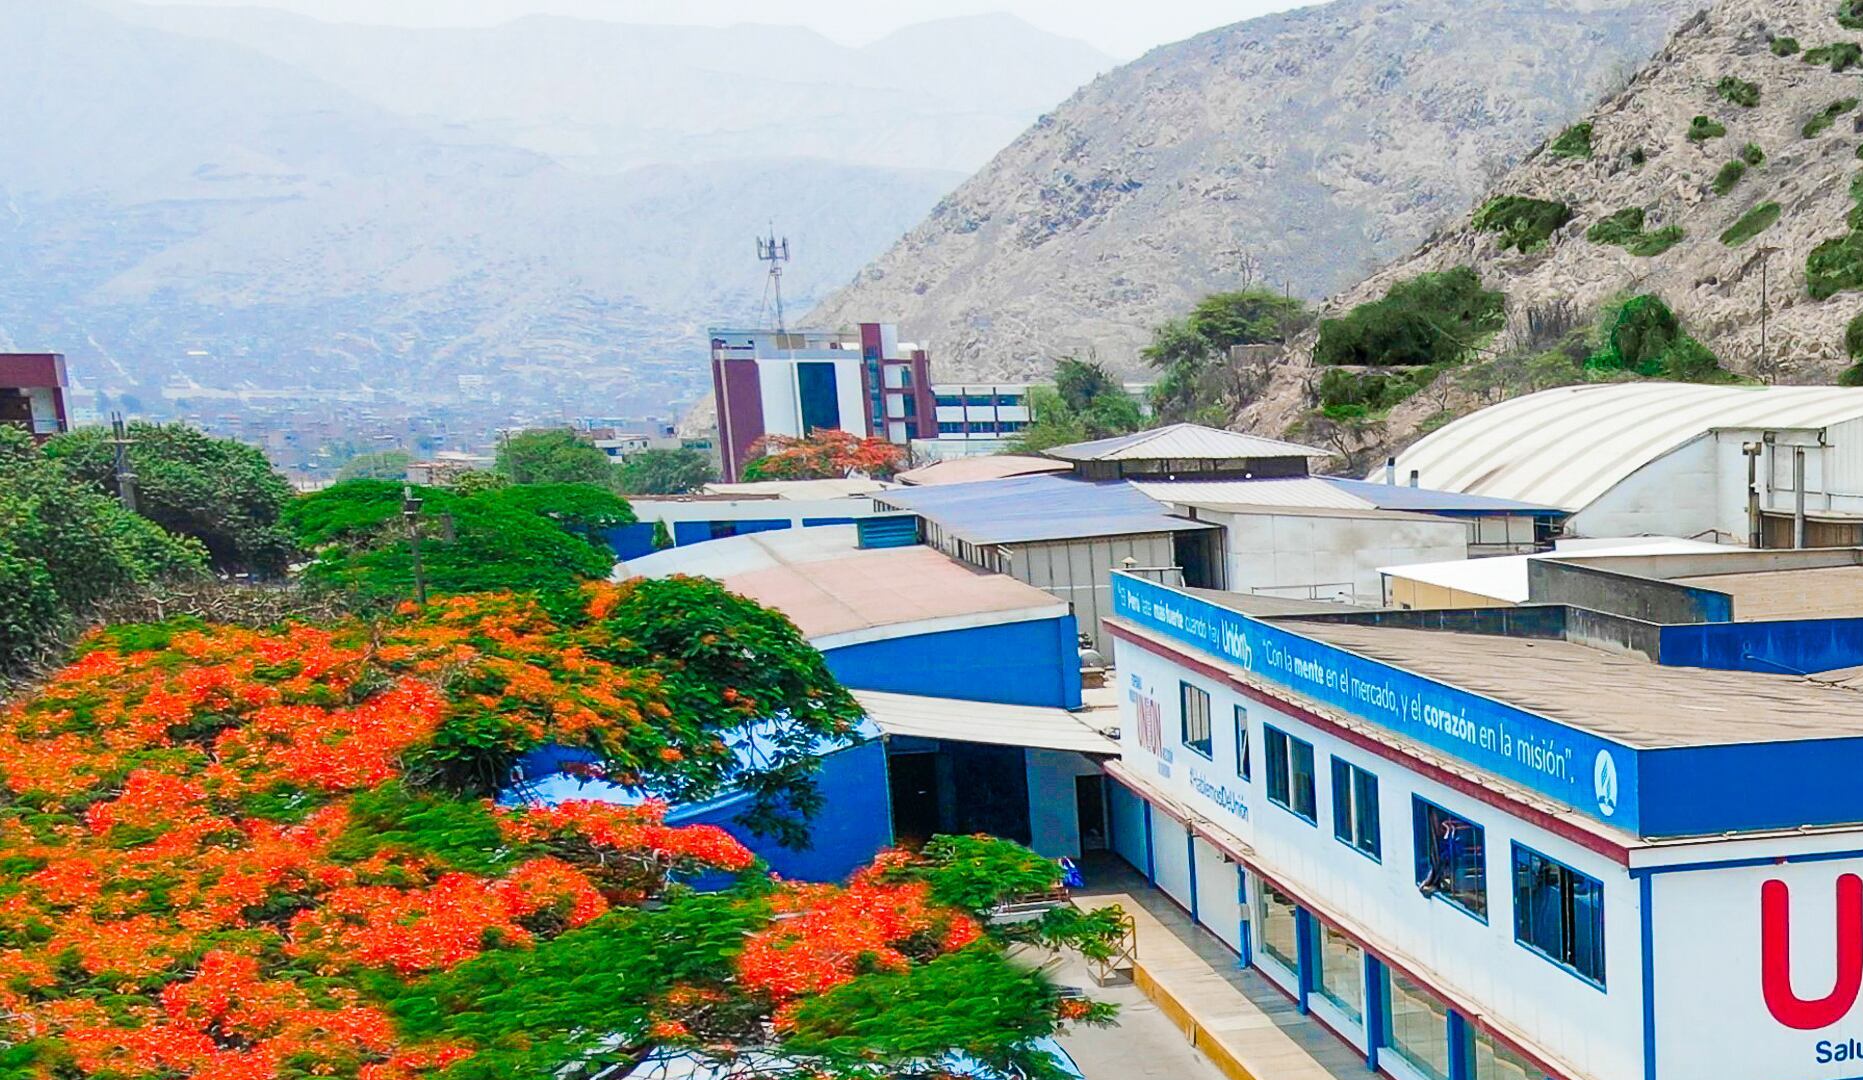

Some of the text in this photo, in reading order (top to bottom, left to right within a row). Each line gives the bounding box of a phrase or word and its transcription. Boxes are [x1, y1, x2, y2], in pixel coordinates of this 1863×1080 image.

[1185, 614, 1207, 639] cuando
[1208, 621, 1220, 650] hay
[1222, 617, 1248, 663] Unión
[1285, 651, 1293, 674] la
[1294, 657, 1324, 684] mente
[1326, 668, 1338, 689] en
[1339, 670, 1350, 695] el
[1352, 677, 1399, 716] mercado,
[1400, 693, 1408, 722] y
[1411, 692, 1422, 722] el
[1423, 706, 1477, 744] corazón
[1479, 726, 1496, 752] en
[1500, 722, 1512, 756] la
